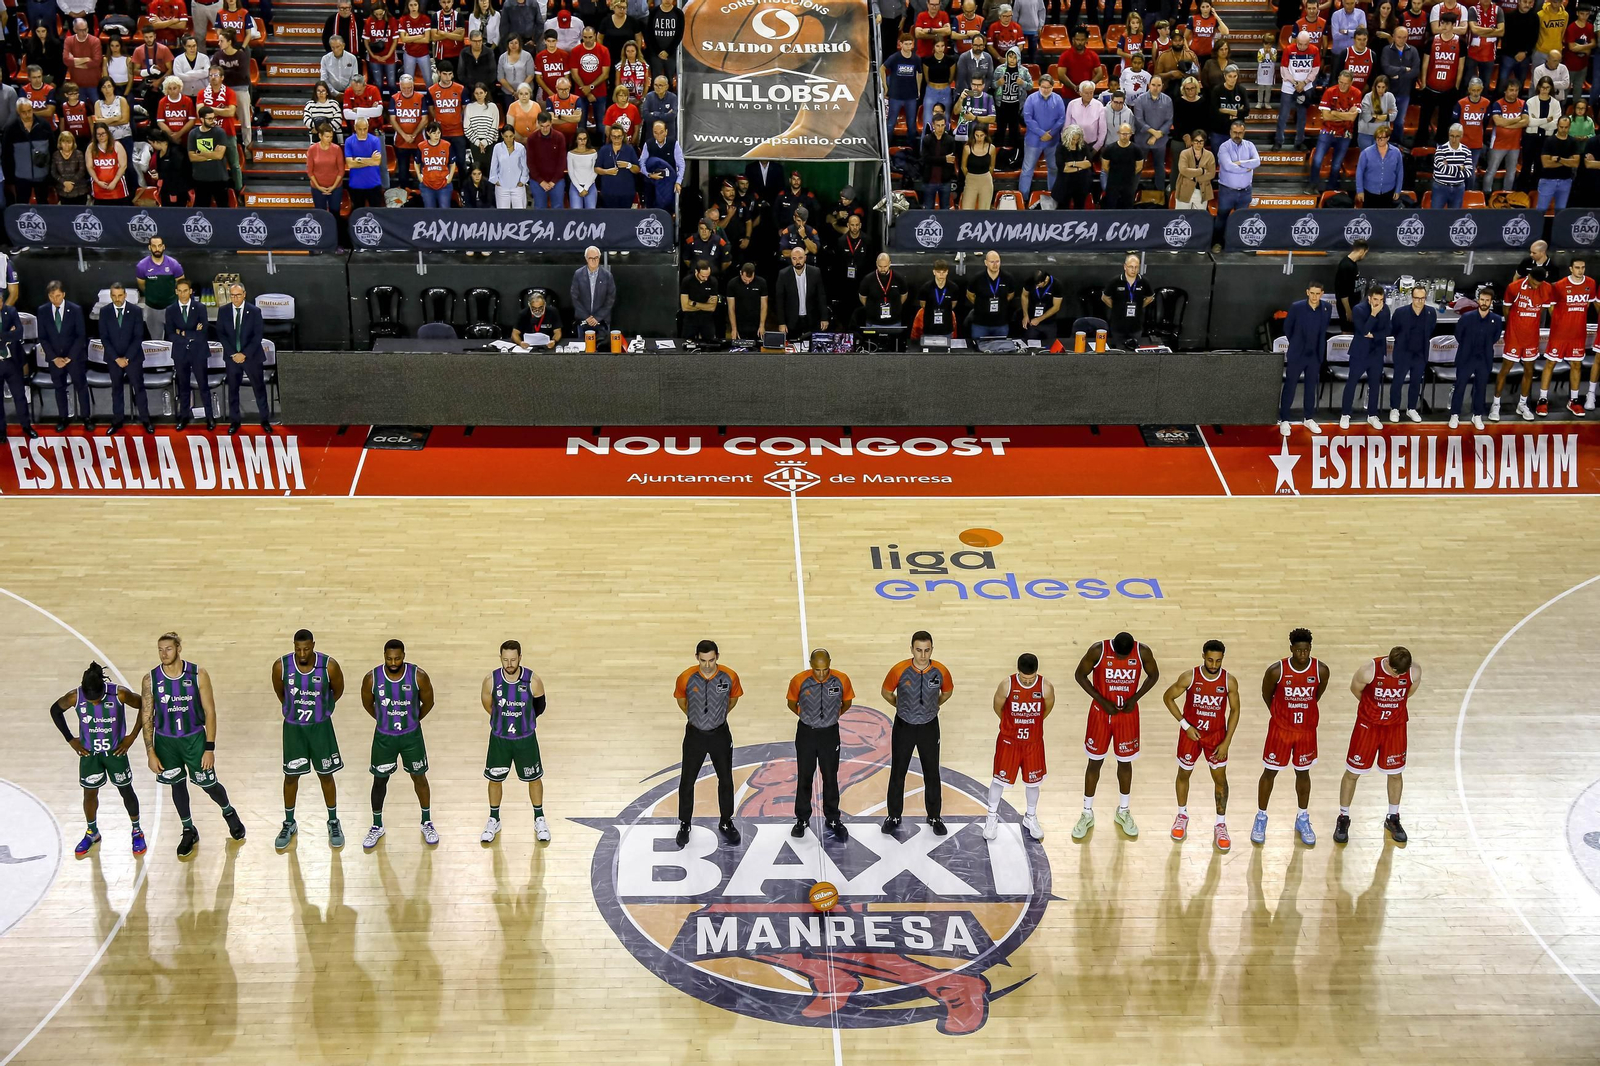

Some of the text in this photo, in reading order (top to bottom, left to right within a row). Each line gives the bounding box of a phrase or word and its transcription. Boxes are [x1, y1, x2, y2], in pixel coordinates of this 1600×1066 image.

[655, 18, 676, 29] AERO
[1543, 20, 1565, 28] VANS
[1195, 26, 1214, 34] BAXI
[702, 40, 851, 54] SALIDO CARRIÓ
[1434, 52, 1456, 60] BAXI
[544, 63, 564, 71] BAXI
[1348, 65, 1370, 74] BAXI
[702, 83, 855, 102] INLLOBSA
[436, 100, 459, 108] BAXI
[717, 102, 840, 110] IMMOBILIÀRIA
[165, 110, 187, 118] BAXI
[396, 108, 420, 118] BAXI
[693, 134, 867, 147] www.grupsalido.com
[424, 157, 446, 166] BAXI
[18, 222, 46, 230] BAXI
[74, 222, 101, 230] BAXI
[130, 224, 158, 232] BAXI
[184, 224, 212, 232] BAXI
[240, 226, 266, 234] BAXI
[295, 226, 321, 234] BAXI
[356, 226, 382, 234] BAXI
[412, 219, 606, 242] BAXIMANRESA.COM
[1574, 226, 1598, 234] BAXI
[917, 228, 942, 236] BAXI
[956, 220, 1150, 243] BAXIMANRESA.COM
[1166, 228, 1190, 236] BAXI
[1240, 227, 1266, 235] BAXI
[1293, 227, 1318, 235] BAXI
[1346, 227, 1371, 235] BAXI
[1399, 227, 1424, 235] BAXI
[1452, 227, 1476, 235] BAXI
[1504, 227, 1529, 235] BAXI
[1566, 294, 1590, 302] BAXI
[144, 346, 170, 354] utuacat
[566, 436, 1010, 456] NOU CONGOST
[7, 434, 306, 490] ESTRELLA DAMM
[1311, 434, 1580, 490] ESTRELLA DAMM
[626, 472, 954, 485] Ajuntament de Manresa
[870, 543, 996, 574] liga
[874, 572, 1164, 600] endesa
[1105, 668, 1136, 680] BAXI
[1284, 686, 1314, 697] BAXI
[1374, 688, 1406, 698] BAXI
[171, 694, 192, 702] Unicaja
[1193, 694, 1224, 706] BAXI
[506, 700, 526, 708] Unicaja
[1010, 702, 1042, 712] BAXI
[298, 709, 312, 722] 77
[1293, 712, 1304, 724] 13
[1380, 710, 1392, 720] 12
[93, 716, 116, 724] Unicaja
[176, 718, 182, 731] 1
[508, 724, 516, 734] 4
[1197, 720, 1210, 731] 24
[1017, 728, 1030, 740] 55
[93, 738, 110, 751] 55
[612, 823, 1034, 897] BAXI
[814, 892, 834, 900] Wilson
[697, 915, 979, 956] MANRESA
